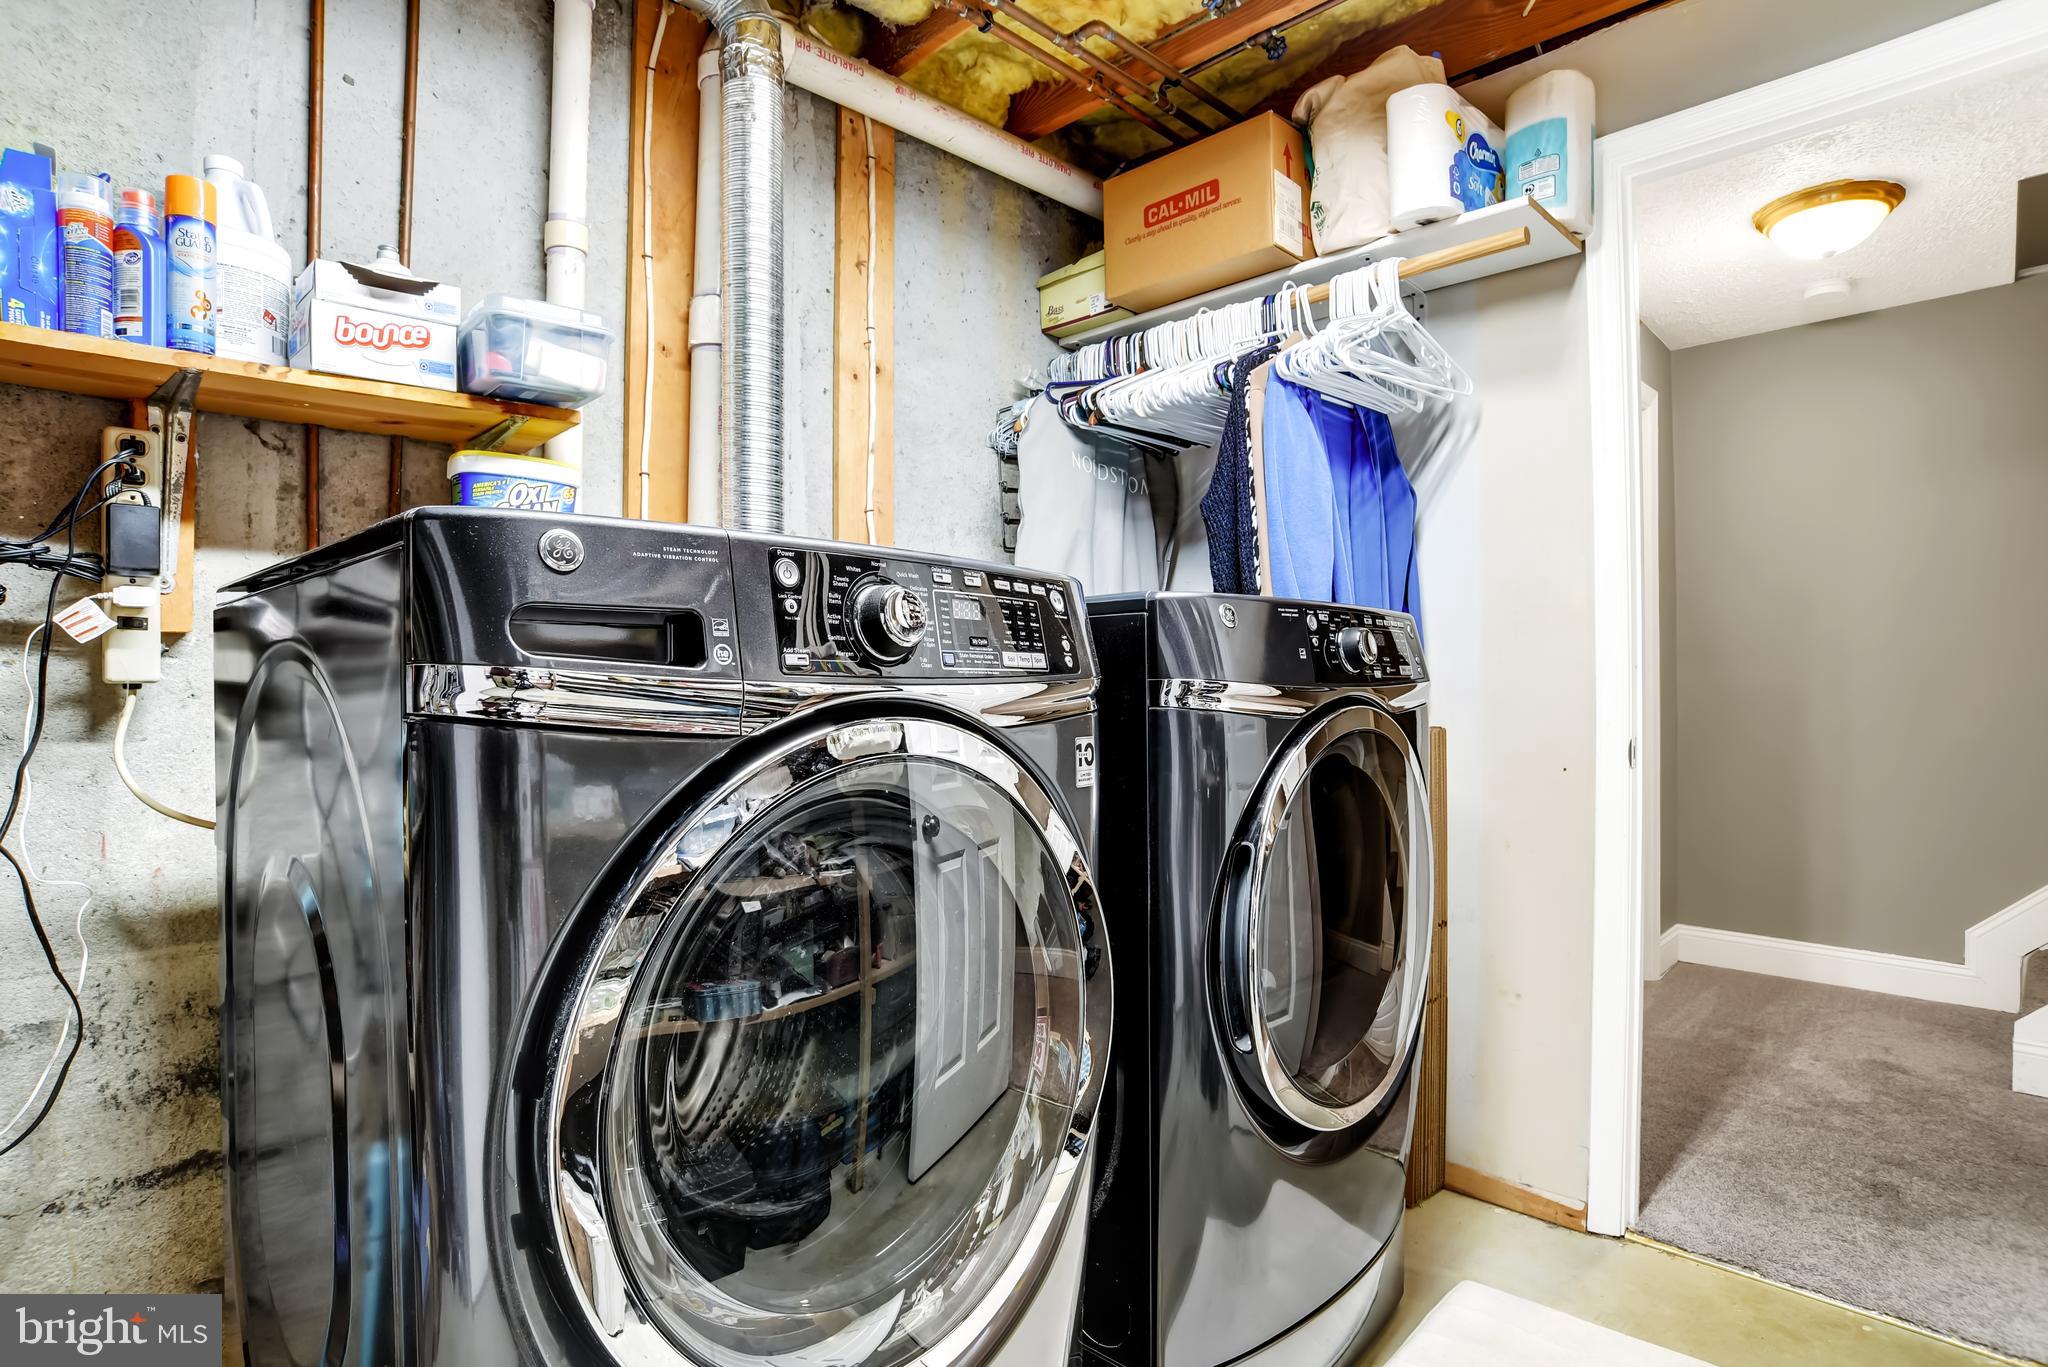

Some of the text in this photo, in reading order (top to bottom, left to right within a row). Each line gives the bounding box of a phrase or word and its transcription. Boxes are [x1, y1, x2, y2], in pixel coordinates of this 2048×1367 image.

[795, 37, 865, 77] CHARLOTTE PIP
[1020, 144, 1072, 176] CHARLOTTE PIPE
[1470, 141, 1497, 167] Charmin
[1468, 176, 1483, 196] Soft
[335, 315, 430, 350] bounce
[508, 482, 548, 506] OXI
[633, 551, 661, 559] ADAPTIVE
[846, 565, 861, 573] Whites
[832, 580, 849, 588] Sheets
[1076, 742, 1095, 767] 10
